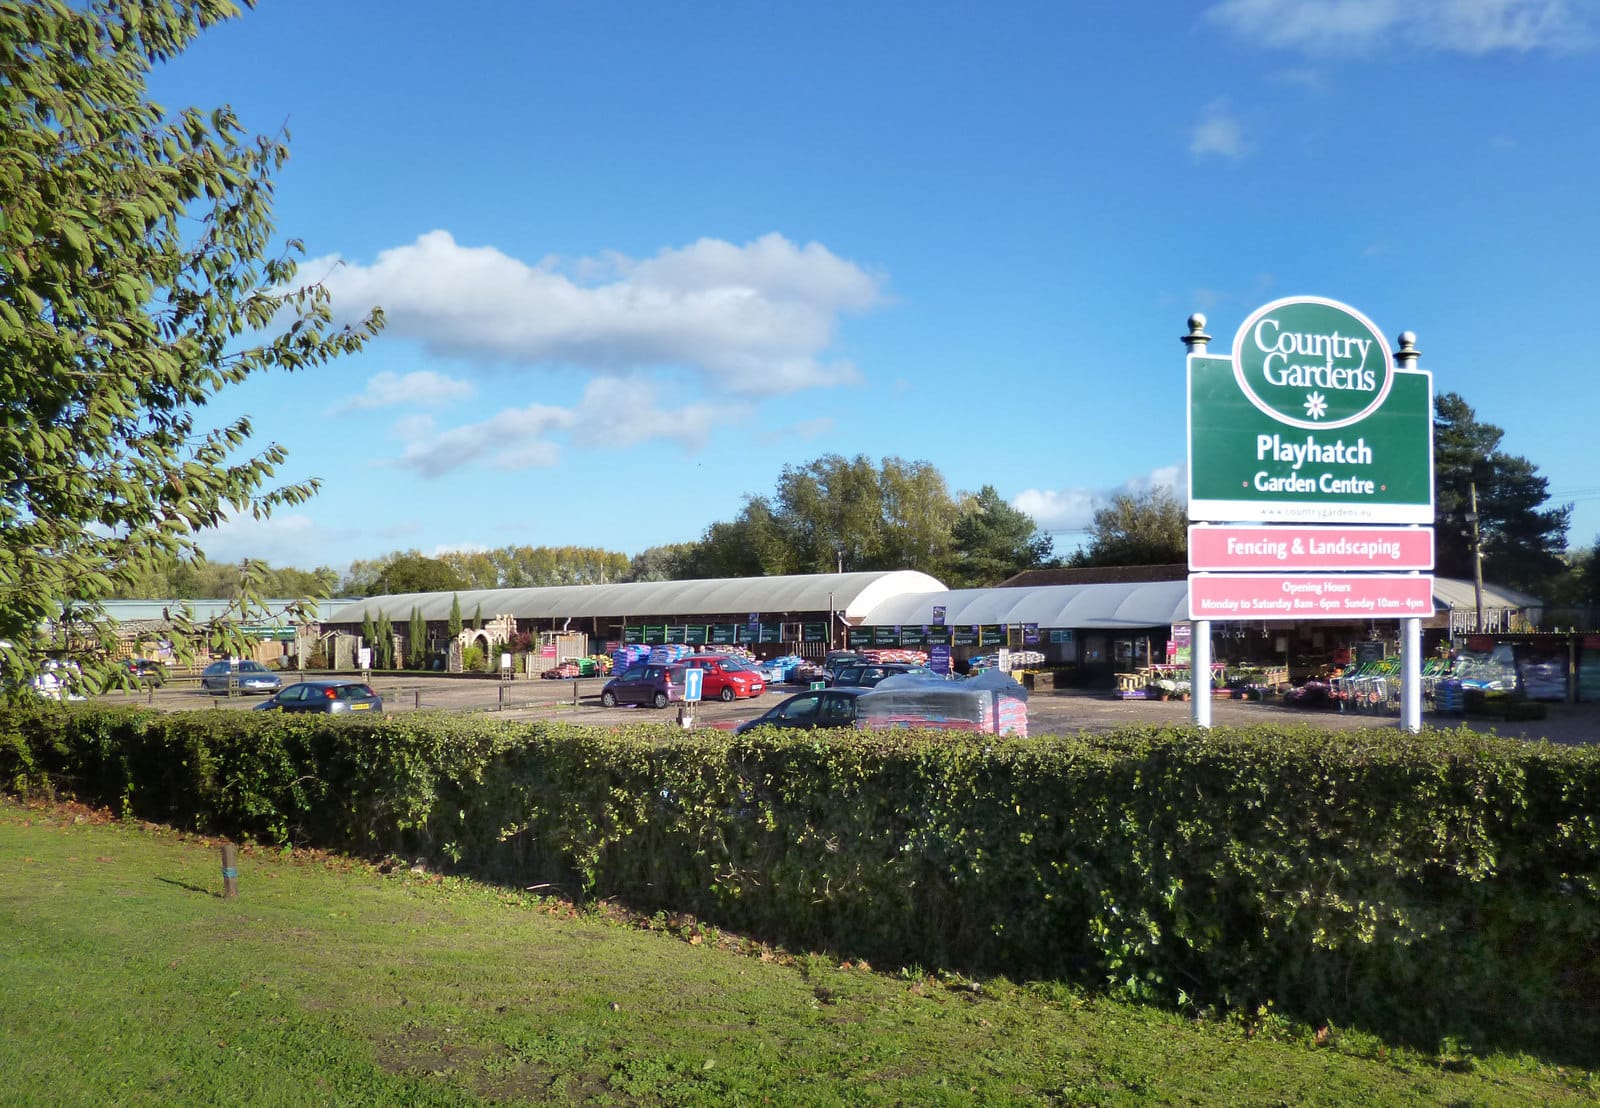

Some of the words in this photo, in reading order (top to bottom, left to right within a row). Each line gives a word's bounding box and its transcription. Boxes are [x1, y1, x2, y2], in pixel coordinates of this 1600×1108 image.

[1254, 319, 1372, 369] Country
[1263, 353, 1376, 391] Gardens
[1257, 434, 1372, 469] Playhatch
[1254, 472, 1316, 493] Garden
[1320, 475, 1374, 494] Centre
[1227, 537, 1287, 559] Fencing
[1292, 539, 1304, 555] &
[1309, 538, 1400, 558] Landscaping
[1282, 582, 1322, 594] Opening
[1324, 582, 1351, 592] Hours
[1201, 598, 1239, 611] Monday
[1240, 600, 1251, 609] to
[1252, 598, 1292, 611] Saturday
[1294, 598, 1313, 608] 8am
[1320, 598, 1340, 611] 6pm
[1344, 598, 1375, 611] Sunday
[1377, 598, 1400, 608] 10am
[1406, 598, 1424, 611] 4pm
